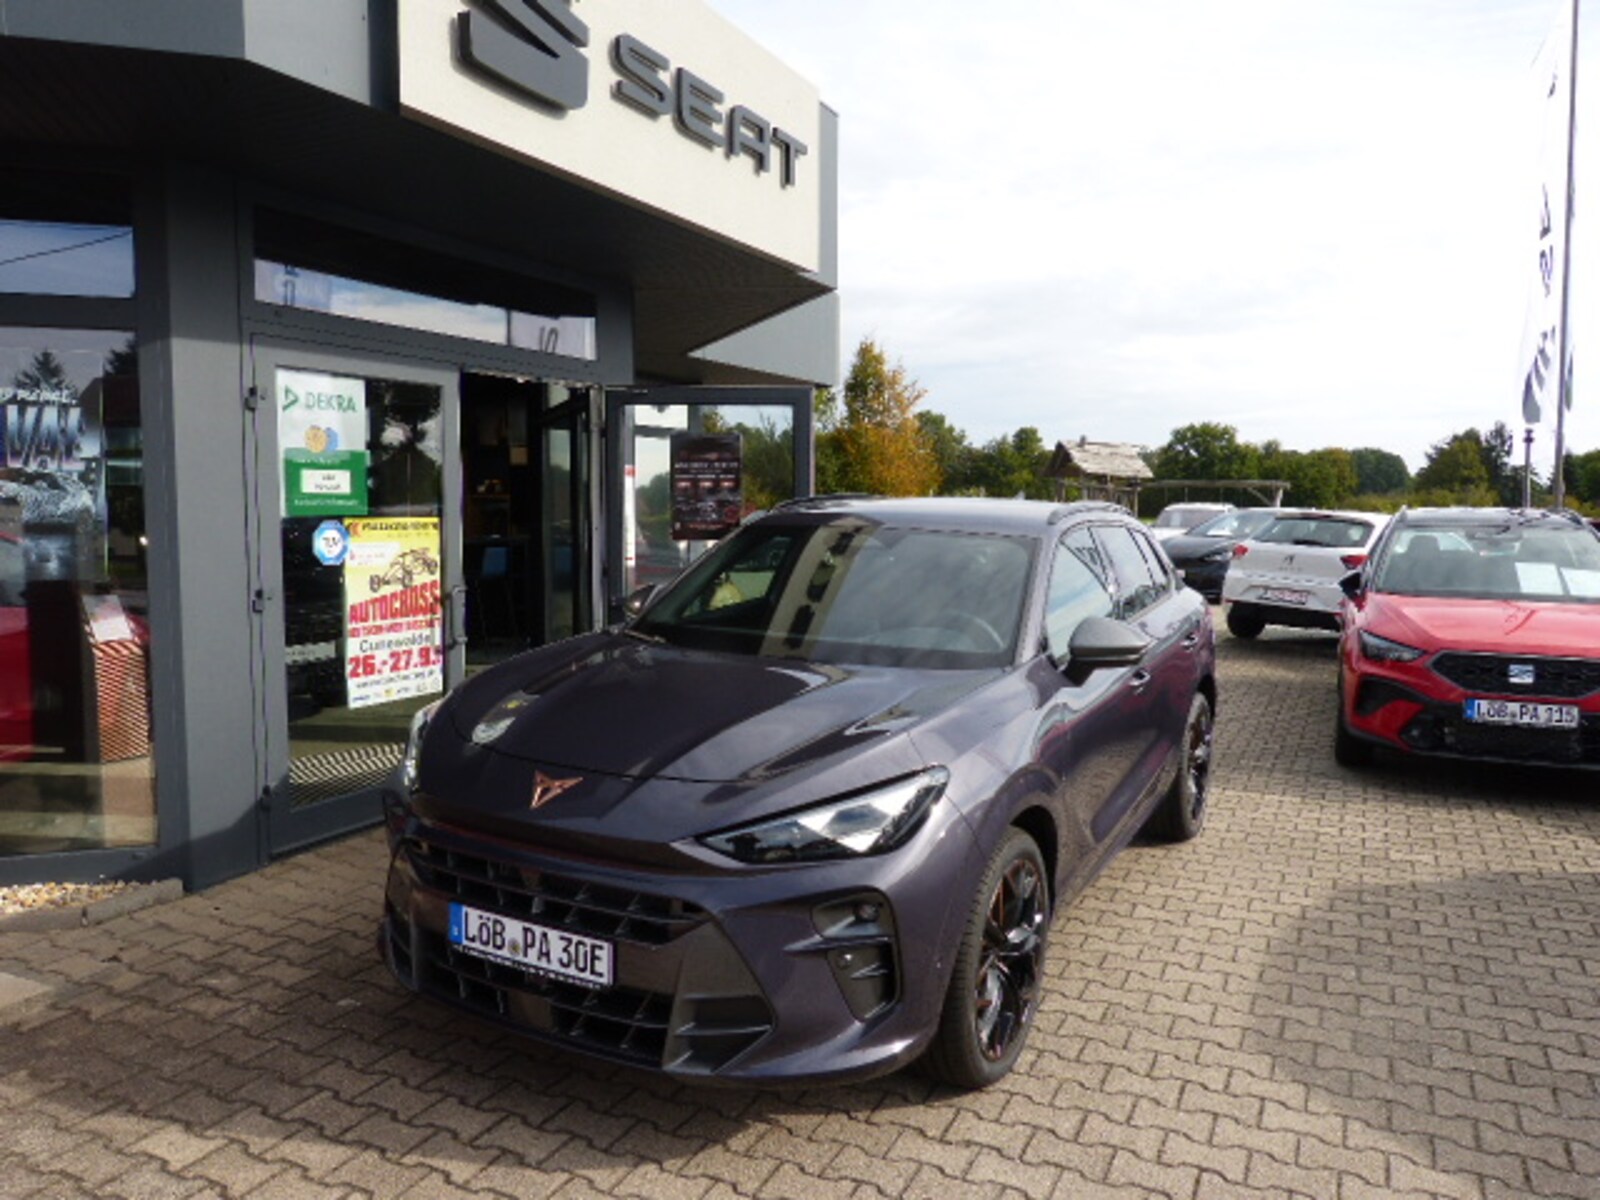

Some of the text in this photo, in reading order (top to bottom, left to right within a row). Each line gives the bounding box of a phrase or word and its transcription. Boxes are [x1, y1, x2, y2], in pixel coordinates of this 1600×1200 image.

[609, 33, 808, 189] SEAT
[304, 391, 357, 413] DEKRA
[349, 579, 441, 625] AUTOCROSS
[522, 926, 552, 964] PA
[559, 936, 604, 978] 30E
